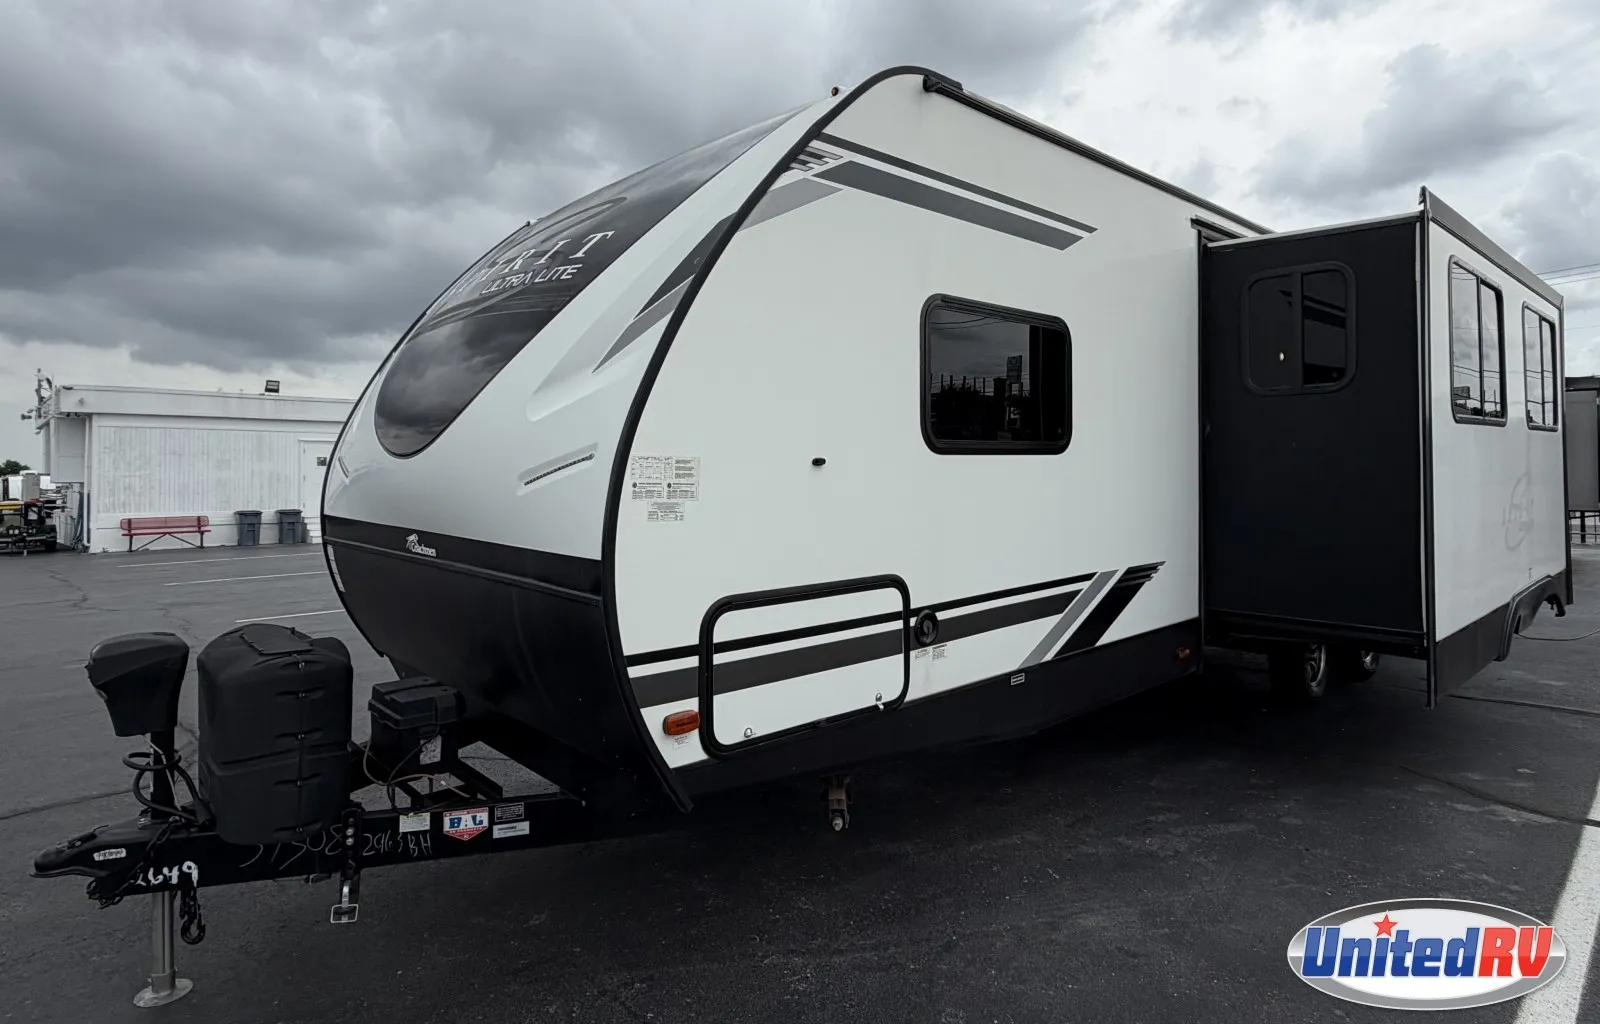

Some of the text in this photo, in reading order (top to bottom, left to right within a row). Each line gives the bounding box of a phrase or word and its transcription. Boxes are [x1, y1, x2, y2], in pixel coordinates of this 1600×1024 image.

[446, 230, 615, 300] IRIT
[481, 264, 583, 294] ULTRA LITE
